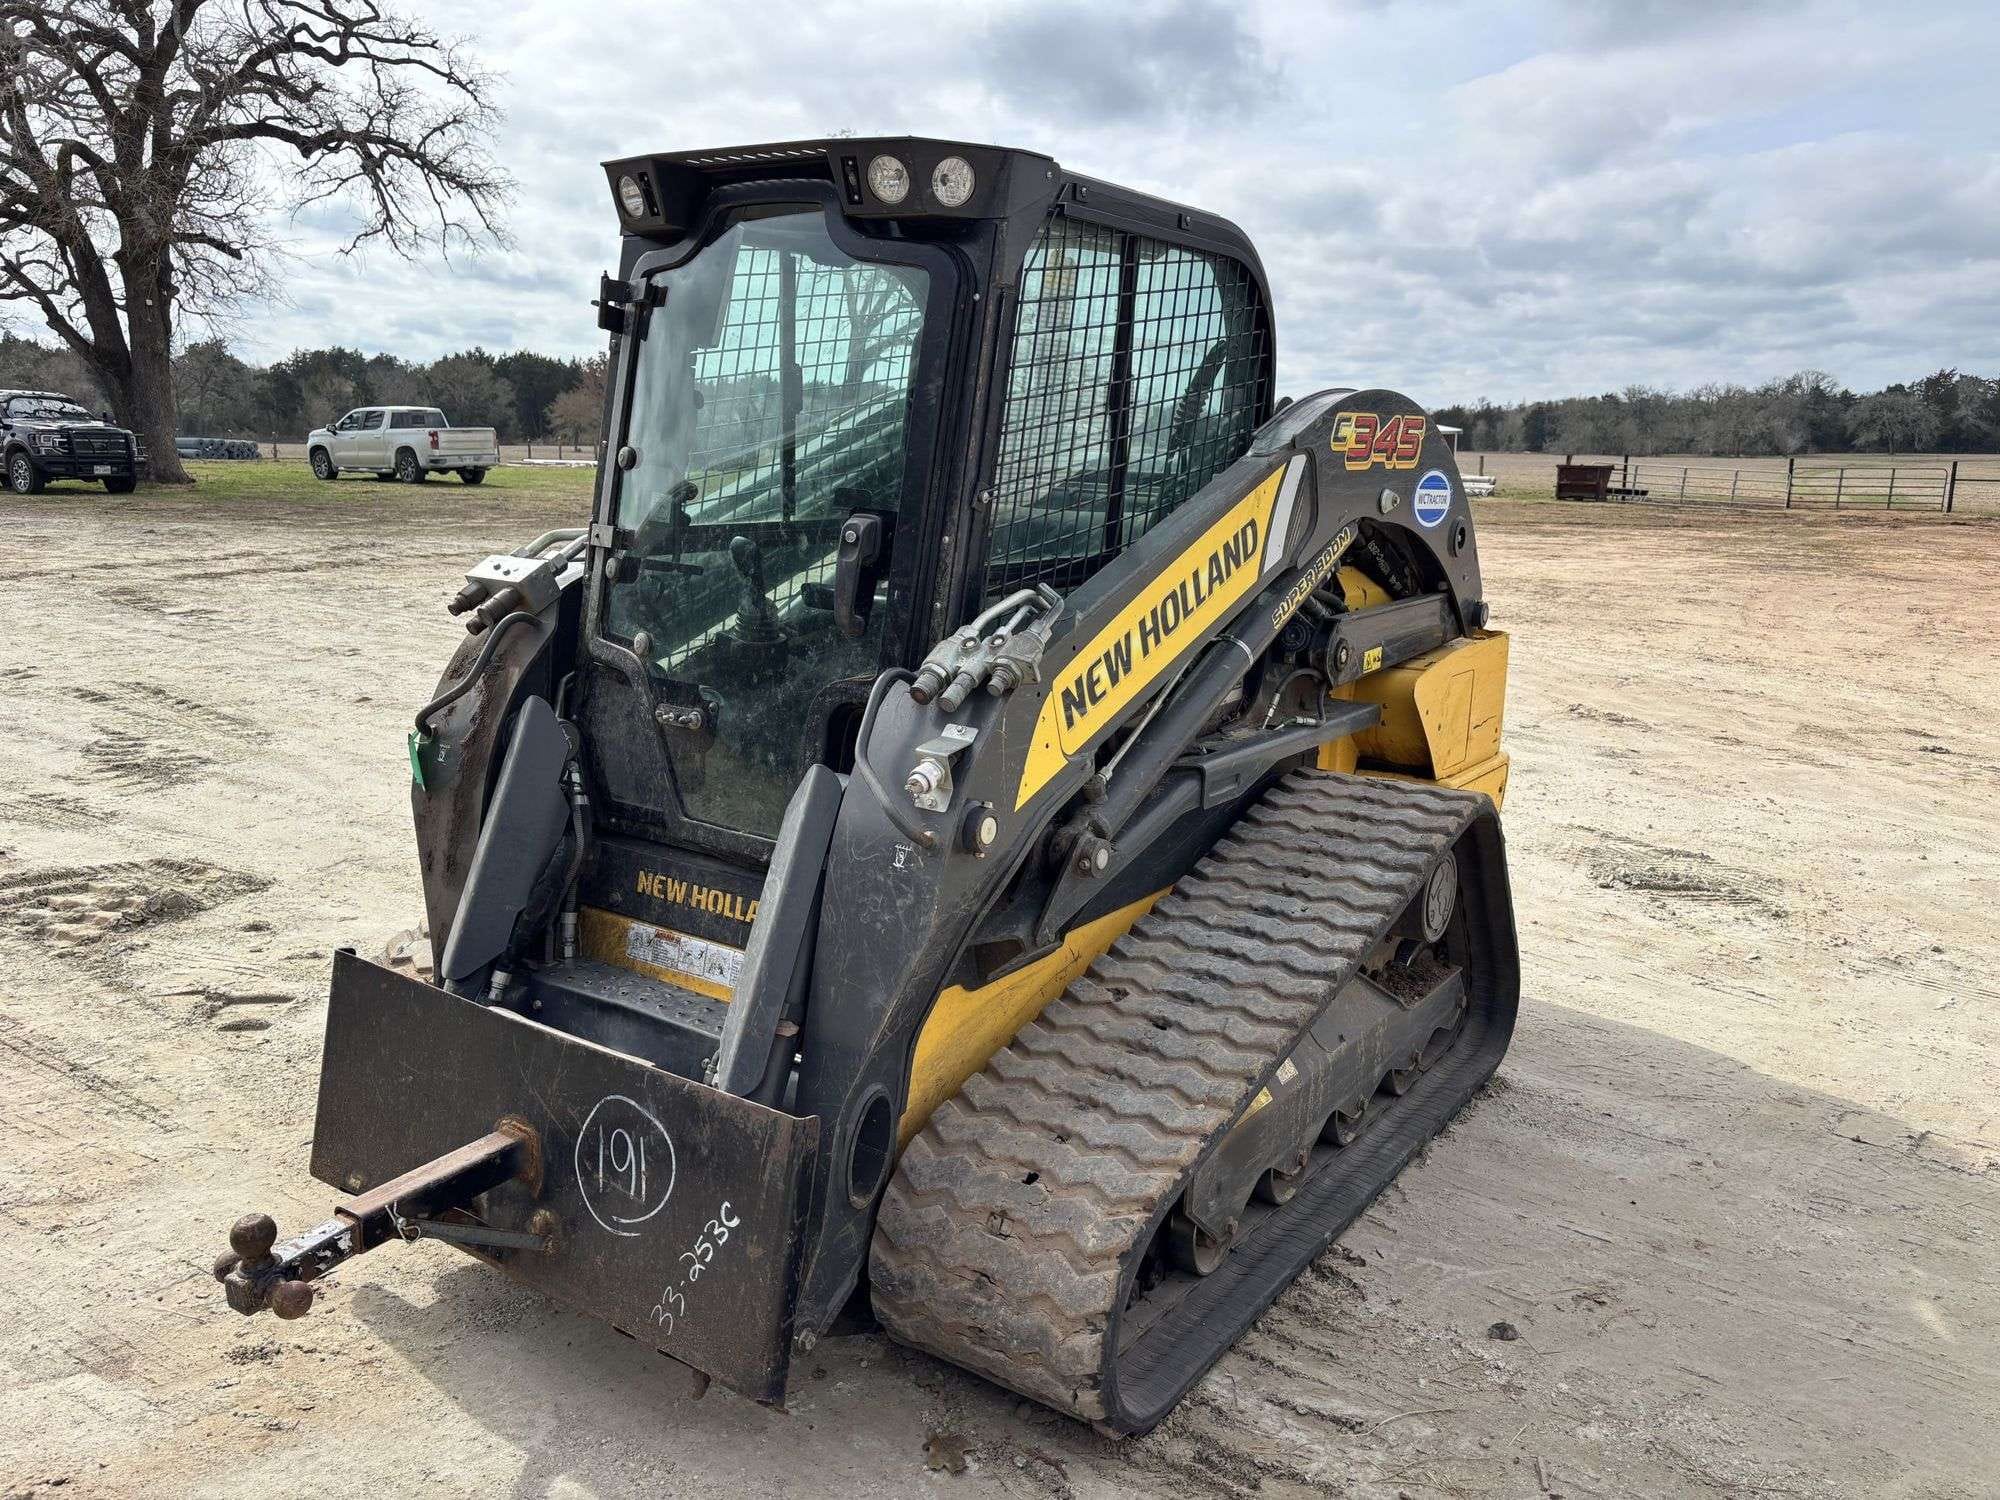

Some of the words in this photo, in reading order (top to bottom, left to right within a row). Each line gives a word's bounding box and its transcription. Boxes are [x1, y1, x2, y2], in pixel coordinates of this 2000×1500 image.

[1060, 628, 1132, 731] NEW
[1138, 517, 1258, 659] HOLLAND
[636, 870, 687, 904] NEW
[598, 1124, 647, 1202] 191
